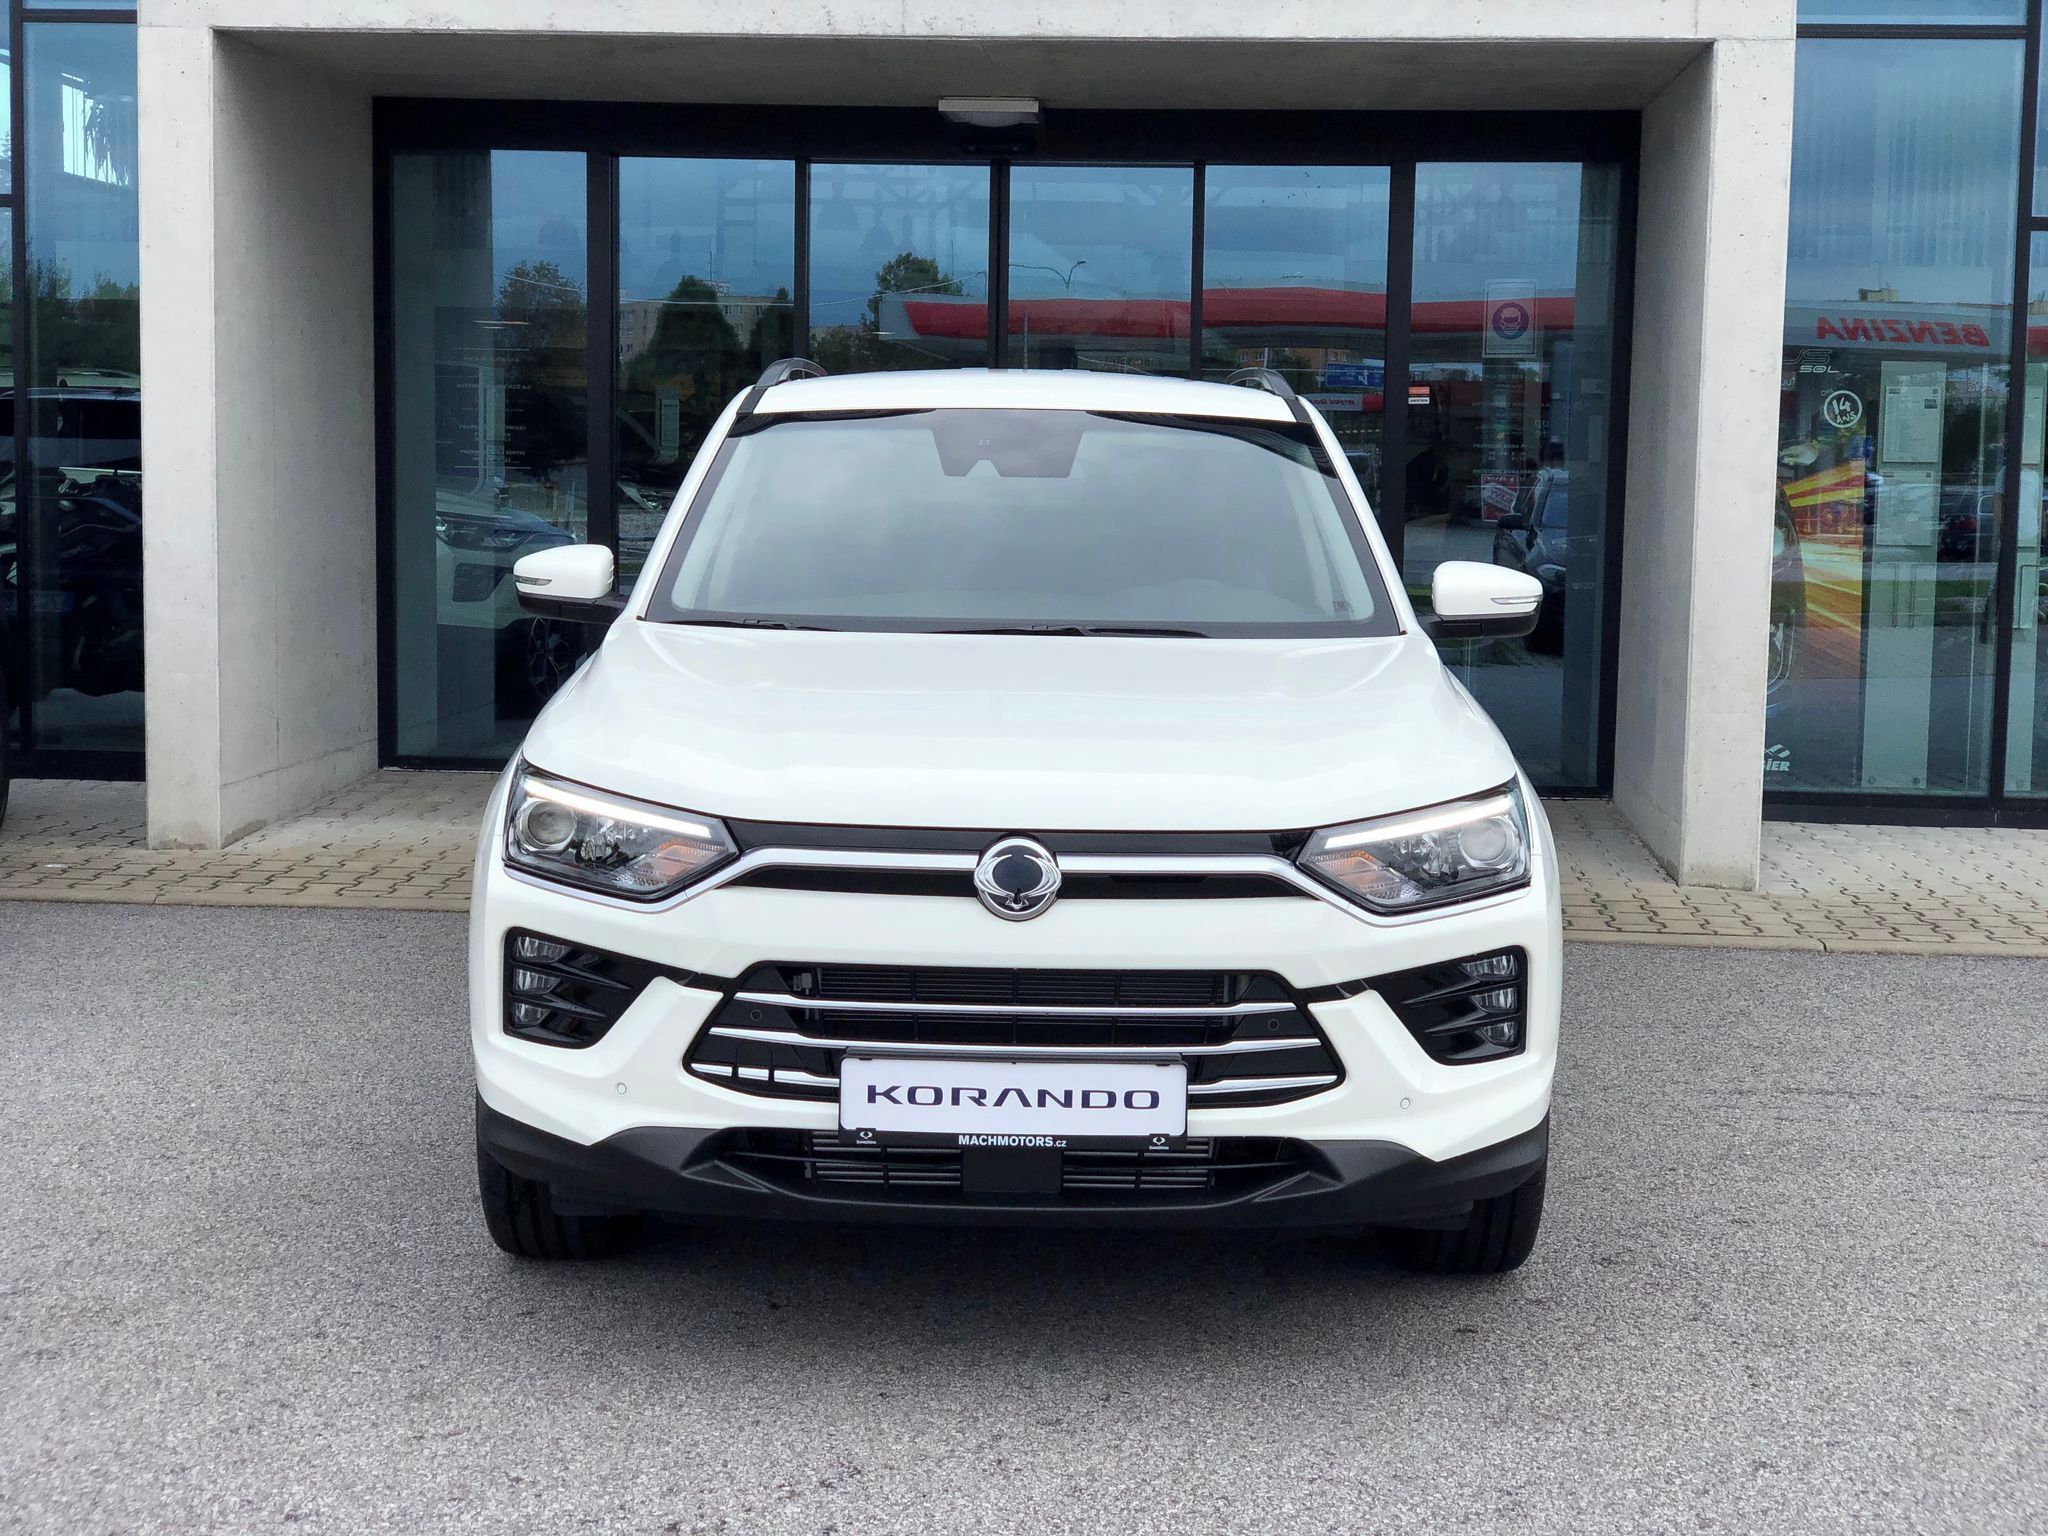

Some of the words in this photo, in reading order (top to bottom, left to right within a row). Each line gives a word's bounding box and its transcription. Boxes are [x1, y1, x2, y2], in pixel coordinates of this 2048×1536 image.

[1798, 365, 1840, 374] SOL
[1832, 396, 1851, 415] 14
[1836, 411, 1857, 424] ANS
[866, 1083, 1161, 1110] KORANDO
[957, 1134, 1067, 1148] MACHMOTORS.cz
